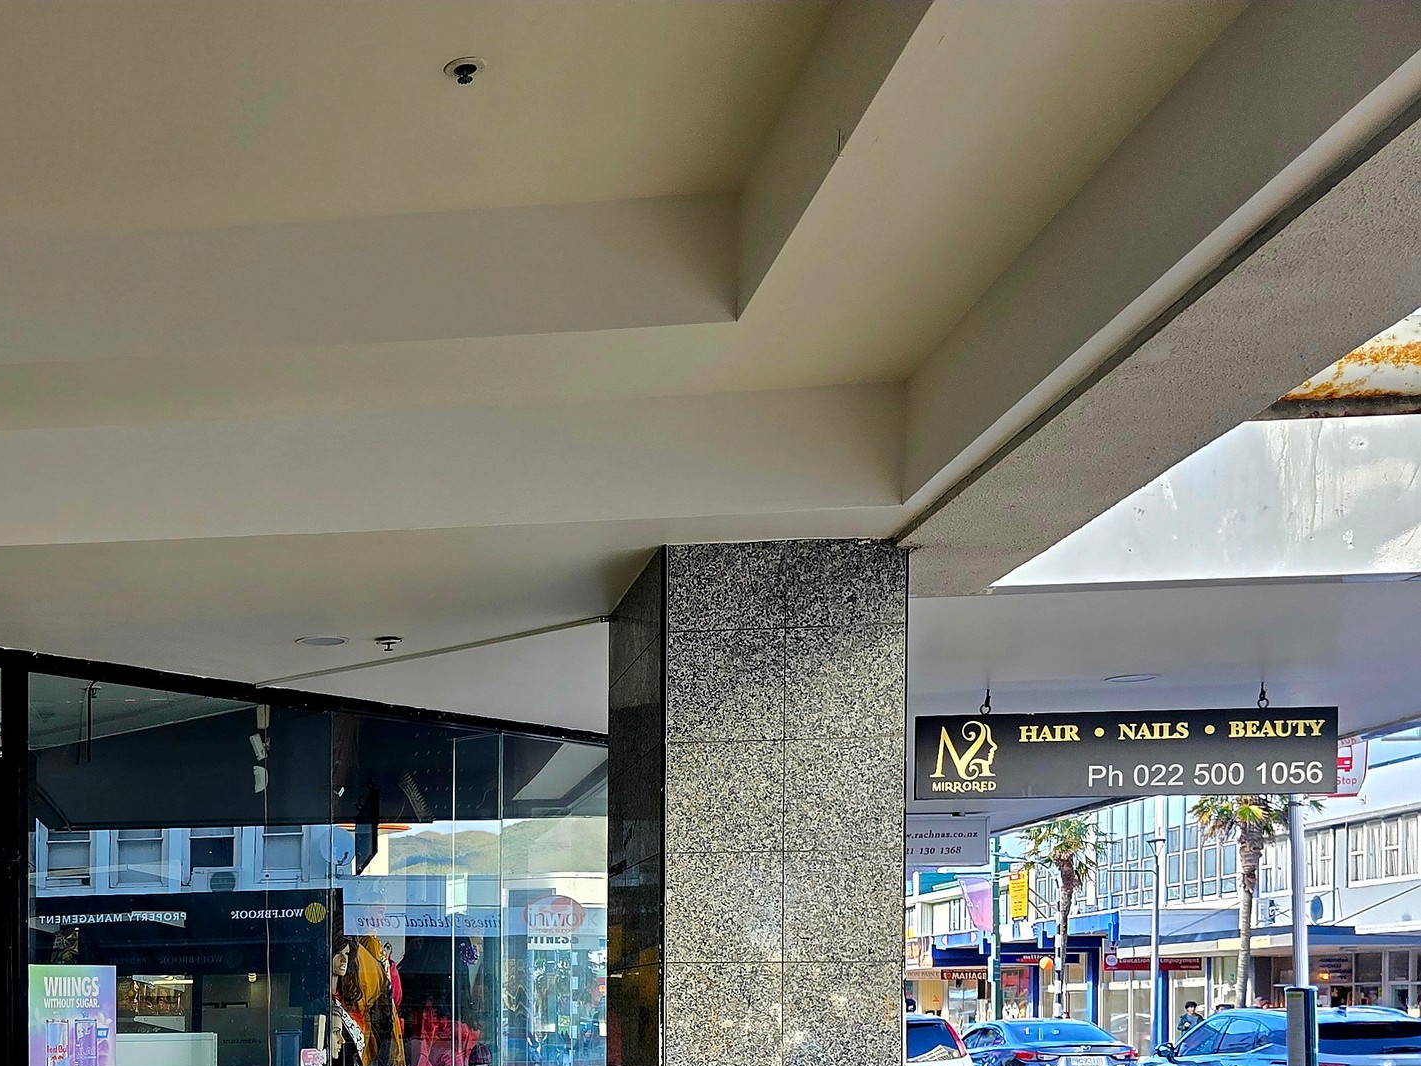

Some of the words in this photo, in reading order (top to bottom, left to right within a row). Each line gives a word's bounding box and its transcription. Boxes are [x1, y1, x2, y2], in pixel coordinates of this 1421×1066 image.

[1018, 725, 1081, 743] HAIR
[1118, 722, 1190, 740] NAILS
[1228, 719, 1325, 738] BEAUTY
[1087, 765, 1123, 787] Ph
[1132, 764, 1184, 787] 022
[1193, 763, 1245, 786] 500
[1255, 761, 1323, 785] 1056
[932, 781, 996, 793] MIRRORED
[1337, 776, 1357, 787] Stop
[920, 847, 935, 856] 130
[940, 846, 962, 855] 1368
[952, 972, 987, 980] MASSAGE
[44, 976, 100, 997] WIIINGS
[44, 998, 74, 1008] WITHOUT
[76, 998, 100, 1008] SUGAR.
